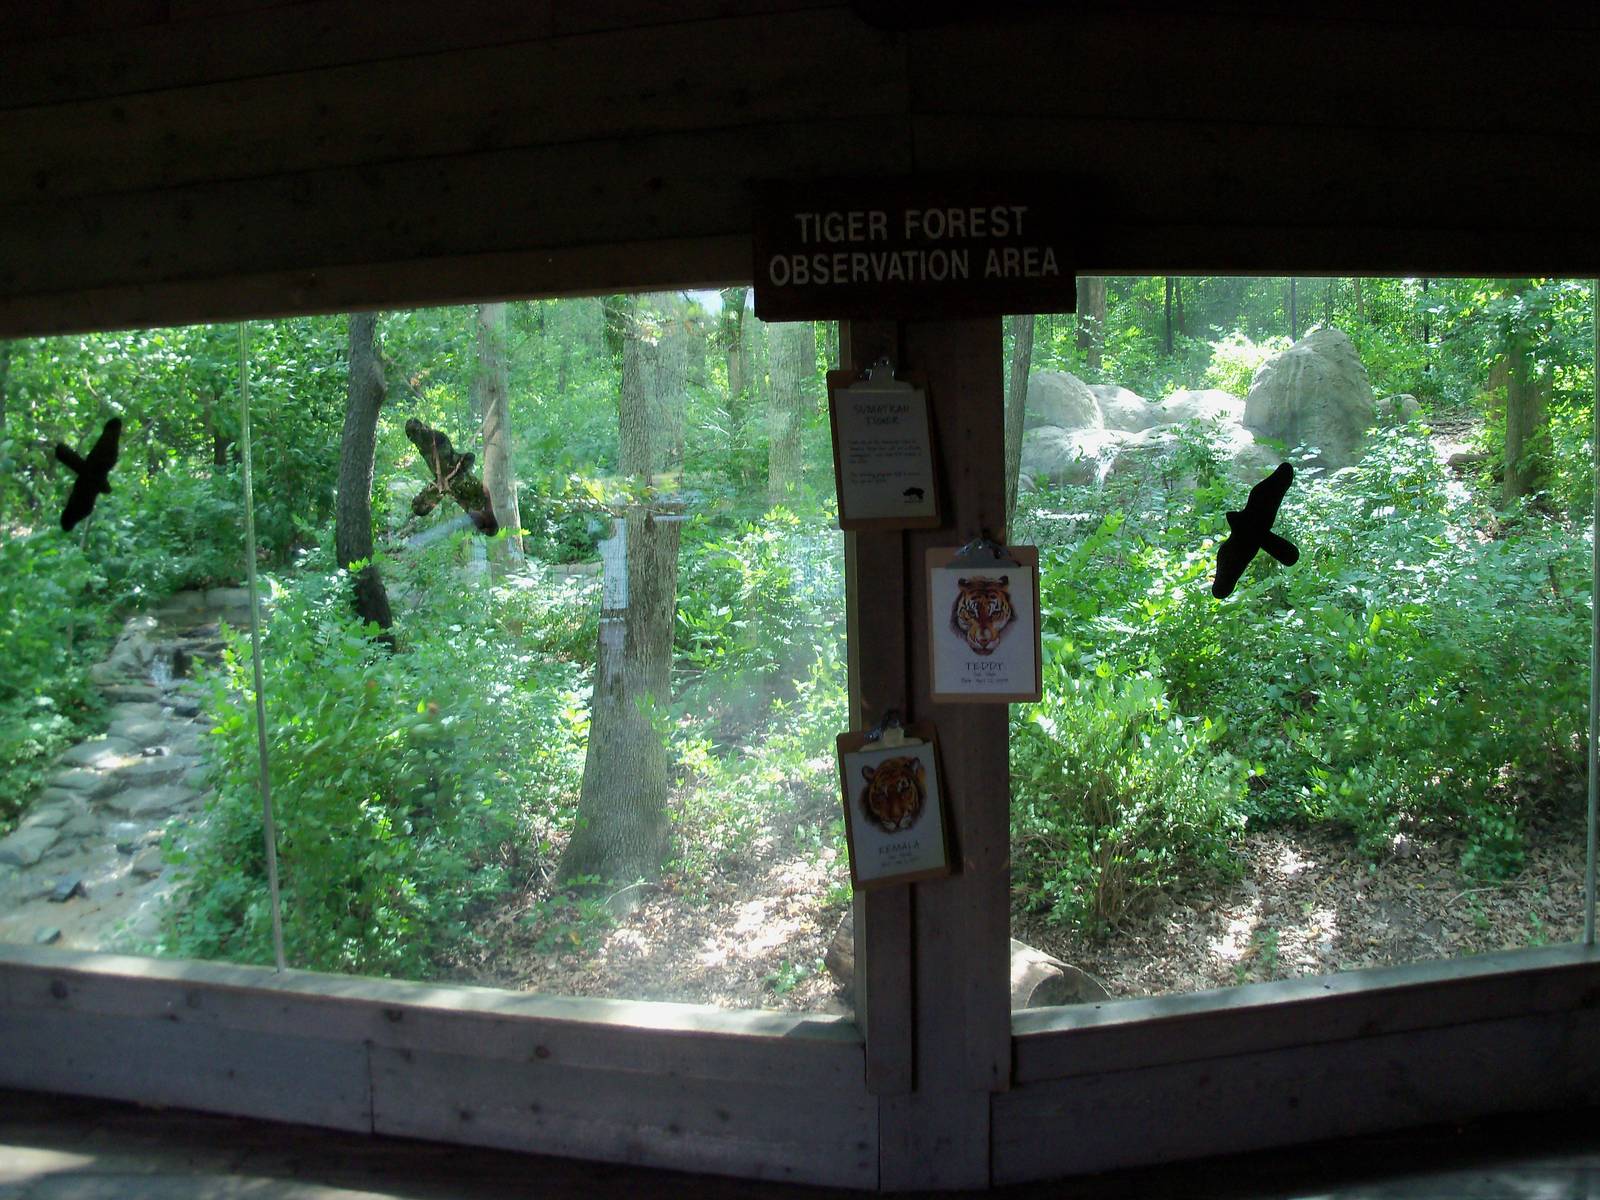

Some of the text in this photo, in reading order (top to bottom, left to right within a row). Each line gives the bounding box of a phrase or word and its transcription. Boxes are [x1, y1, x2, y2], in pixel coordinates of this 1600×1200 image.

[794, 206, 1028, 244] TIGER FOREST
[769, 247, 1060, 287] OBSERVATION AREA
